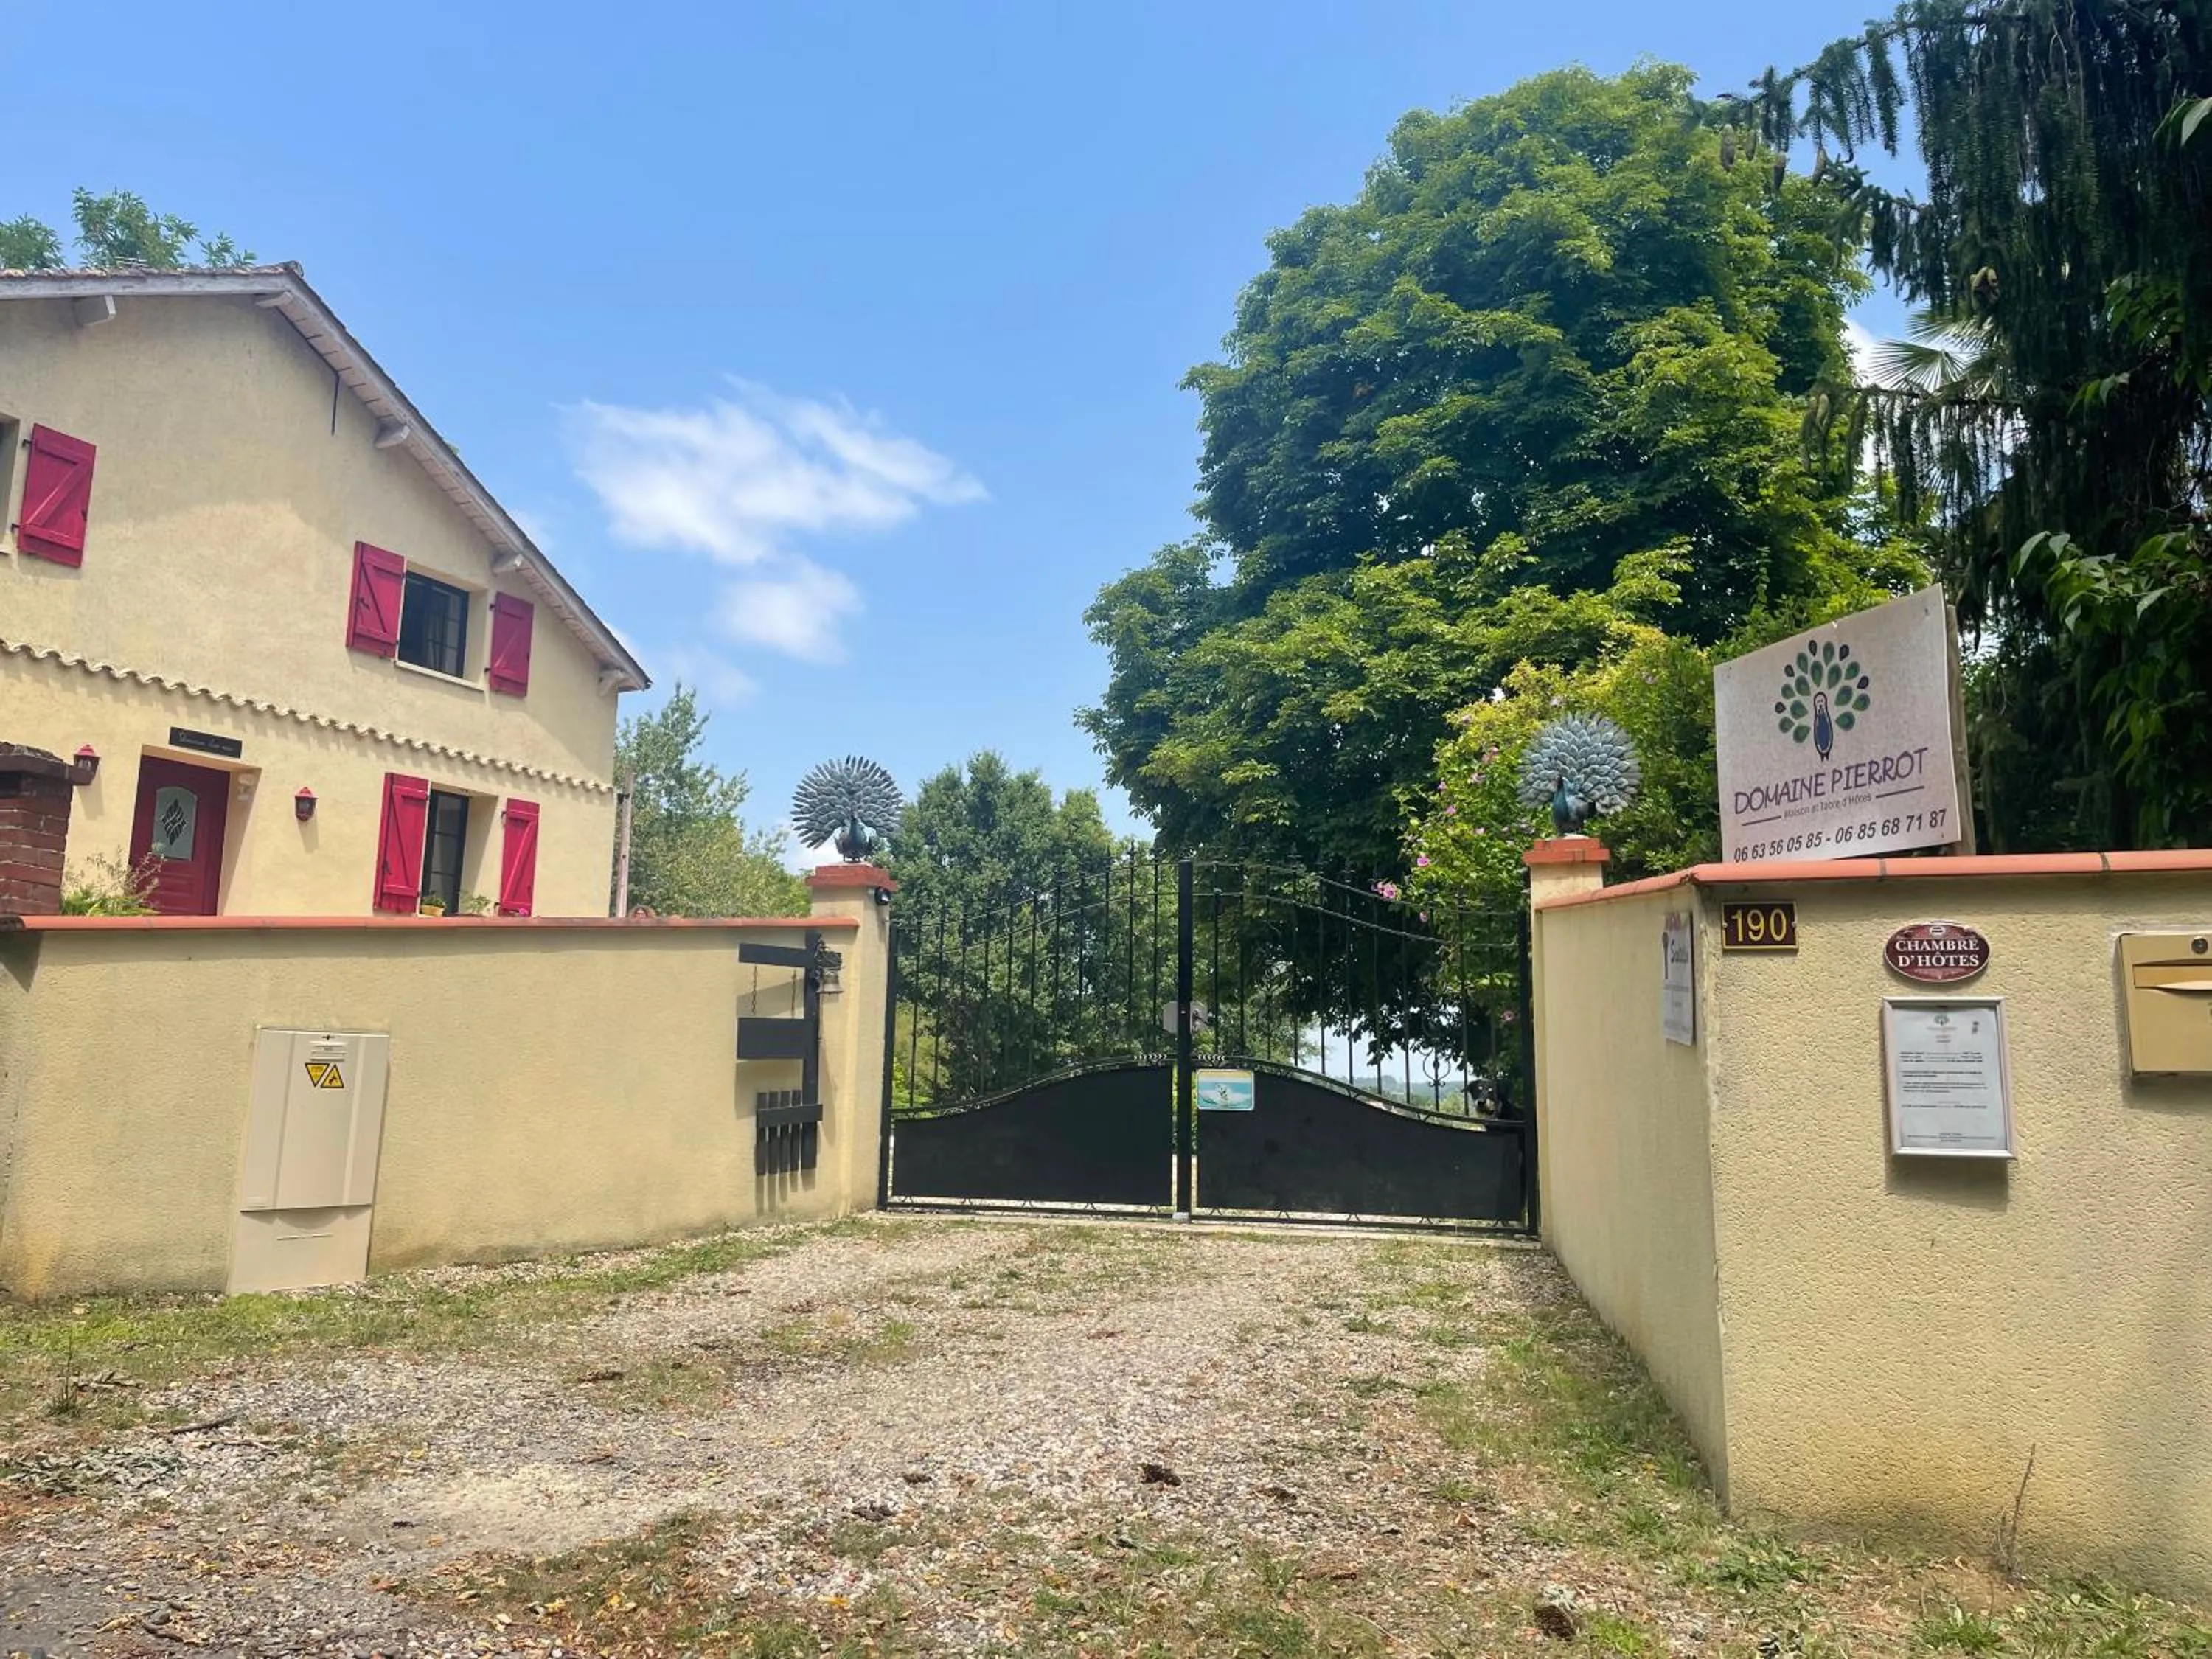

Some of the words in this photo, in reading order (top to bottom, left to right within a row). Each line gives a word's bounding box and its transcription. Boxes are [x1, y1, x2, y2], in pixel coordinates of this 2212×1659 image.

[1734, 773, 1826, 815] DOMAINE
[1831, 746, 1929, 793] PIERROT
[1733, 846, 1748, 863] 06
[1751, 843, 1766, 859] 63
[1769, 839, 1784, 856] 56
[1787, 835, 1803, 852] 05
[1806, 831, 1823, 849] 85
[1835, 825, 1853, 844] 06
[1857, 821, 1877, 840] 85
[1881, 818, 1900, 836] 68
[1906, 813, 1923, 832] 71
[1930, 808, 1947, 828] 87
[1731, 908, 1787, 942] 190
[1895, 939, 1980, 952] CHAMBRE
[1898, 951, 1980, 967] D'HÔTES
